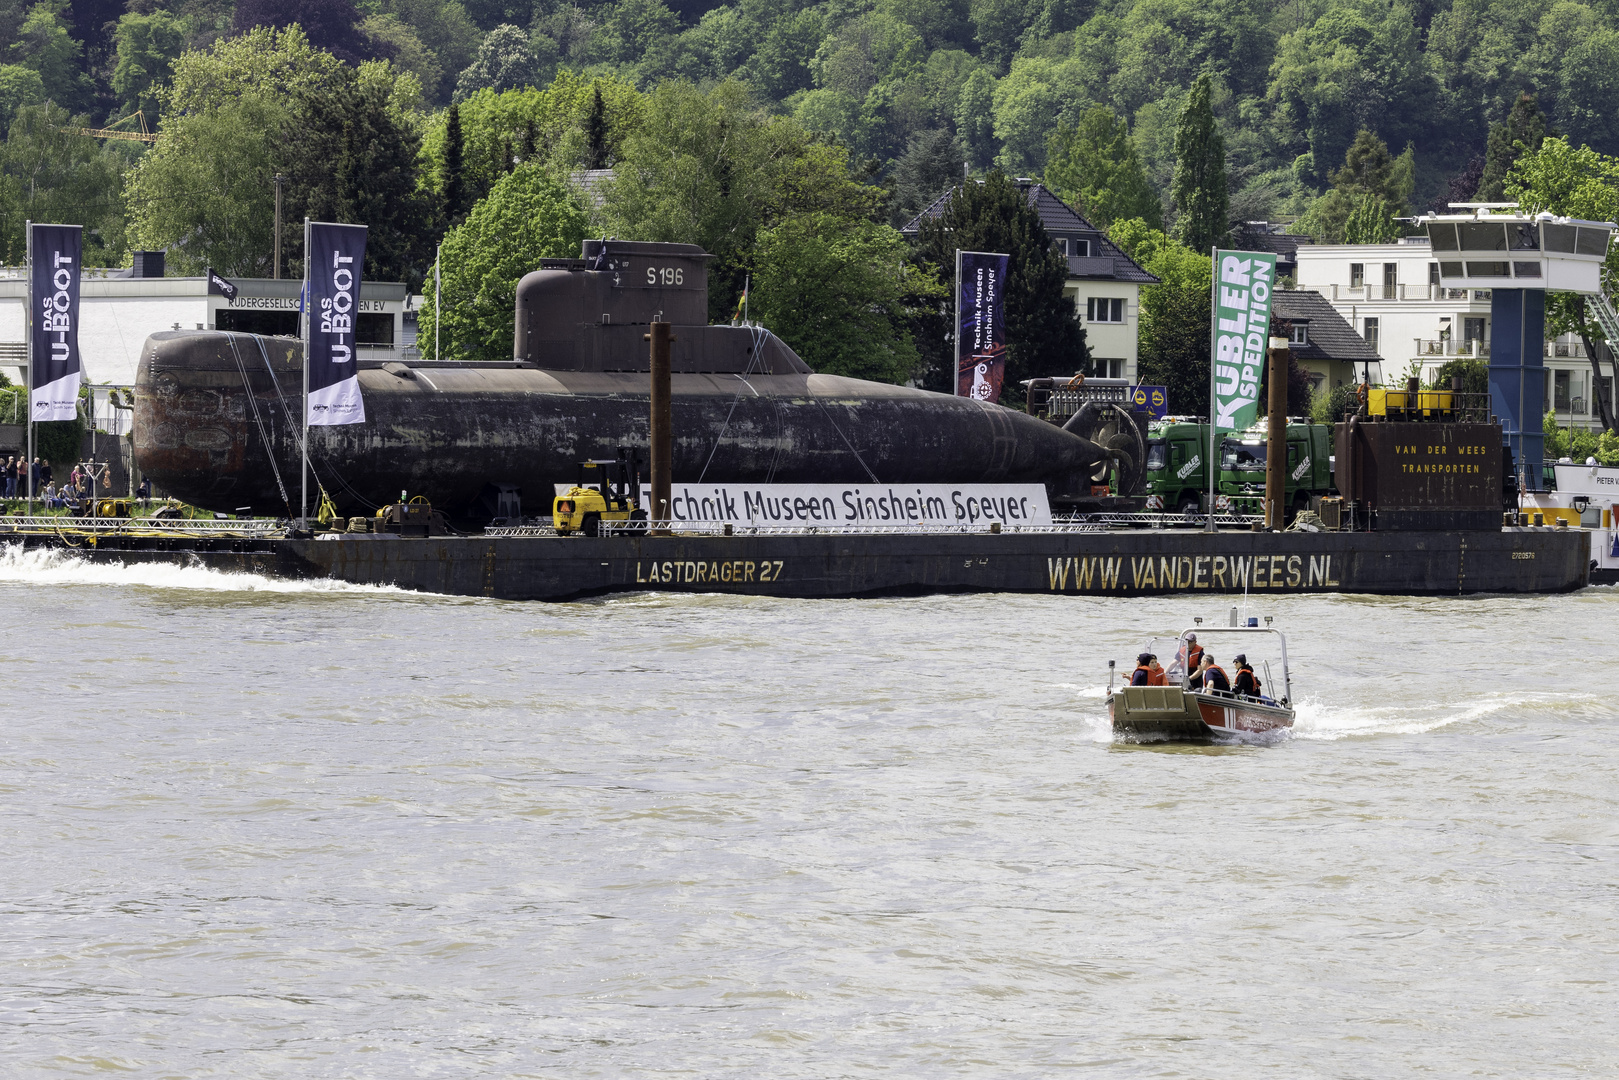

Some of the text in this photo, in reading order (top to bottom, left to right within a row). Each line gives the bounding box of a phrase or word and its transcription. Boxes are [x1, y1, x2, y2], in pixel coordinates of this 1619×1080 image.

[646, 266, 684, 286] S 196
[43, 296, 53, 332] DAS
[51, 250, 73, 361] U-BOOT
[228, 297, 386, 311] RUDERGESELLSC EN EV
[320, 297, 333, 333] DAS
[331, 250, 354, 364] U-BOOT
[973, 267, 984, 350] Technik Museen
[984, 267, 996, 350] Sinsheim Speyer
[1216, 255, 1256, 429] KÜBLER
[1239, 259, 1272, 399] SPEDITION
[1395, 445, 1486, 455] VAN DER WEES
[1402, 464, 1480, 473] TRANSPORTEN
[1596, 476, 1614, 485] PIETER
[642, 488, 1028, 525] Tchnik Museen Sinsheim Speyer
[636, 560, 784, 583] LASTDRAGER 27
[1047, 555, 1340, 590] WWW.VANDERWEES.NL
